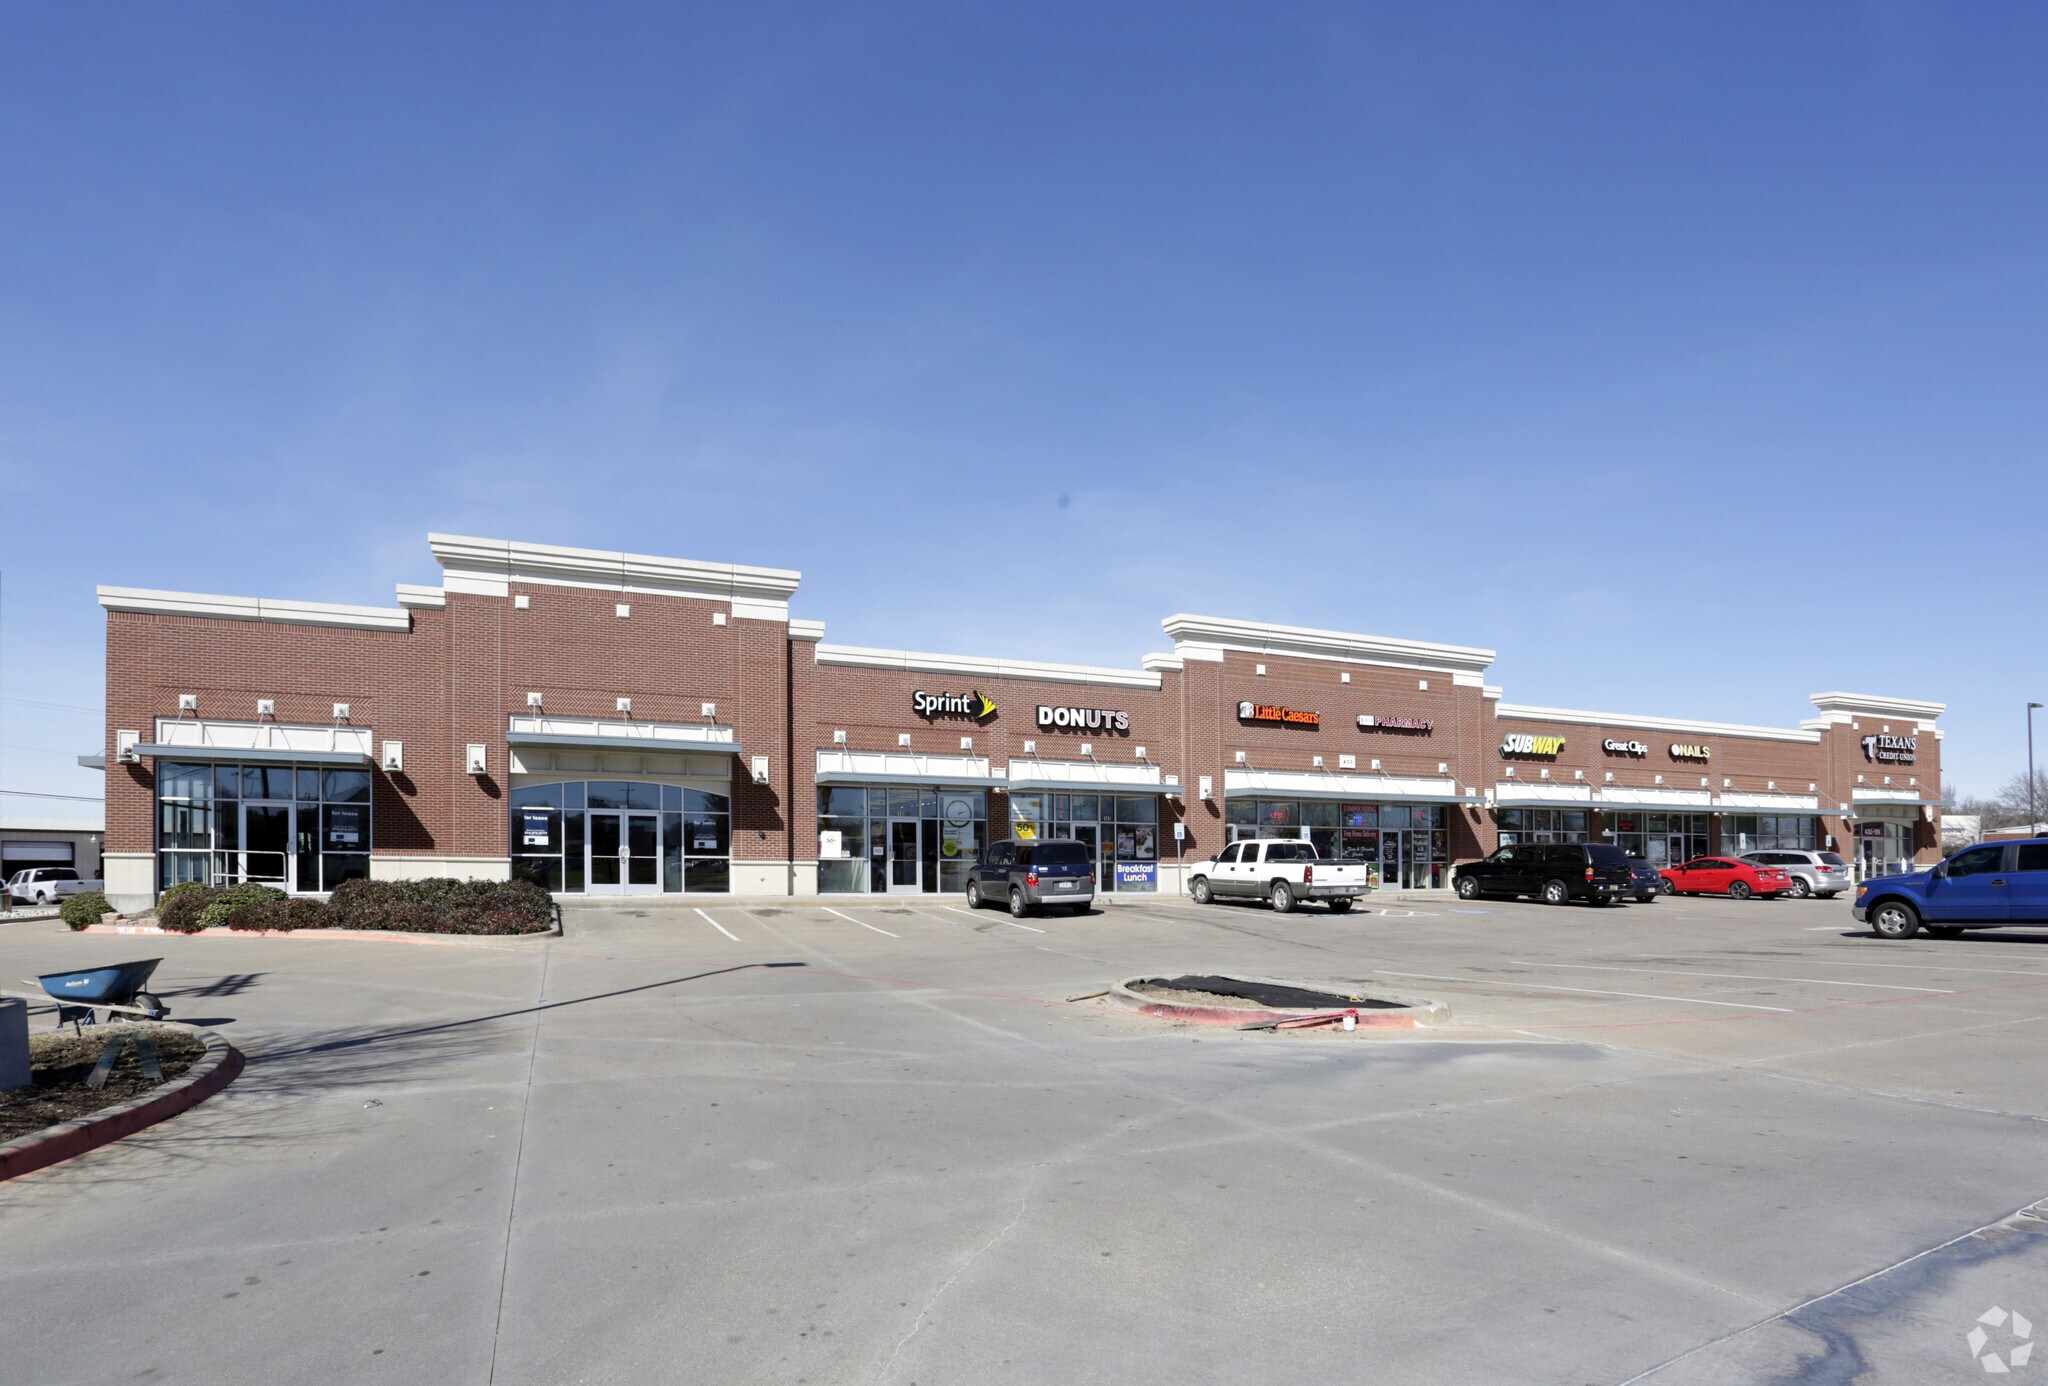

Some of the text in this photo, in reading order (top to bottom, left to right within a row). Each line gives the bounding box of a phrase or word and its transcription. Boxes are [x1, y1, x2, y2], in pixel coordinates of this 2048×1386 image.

[914, 691, 970, 716] Sprint
[1038, 706, 1129, 729] DONUTS
[1255, 704, 1319, 724] Little Caesars
[1375, 716, 1433, 730] PHARMACY
[1502, 734, 1565, 755] SUBWAY
[1604, 739, 1648, 755] Great Clips
[1878, 735, 1917, 750] TEXANS
[1679, 745, 1710, 758] NAILS
[1879, 751, 1917, 761] CREDIT UNION
[1343, 804, 1377, 812] COMPOUNDING
[1117, 864, 1154, 873] Breakfast
[1123, 873, 1148, 882] Lunch
